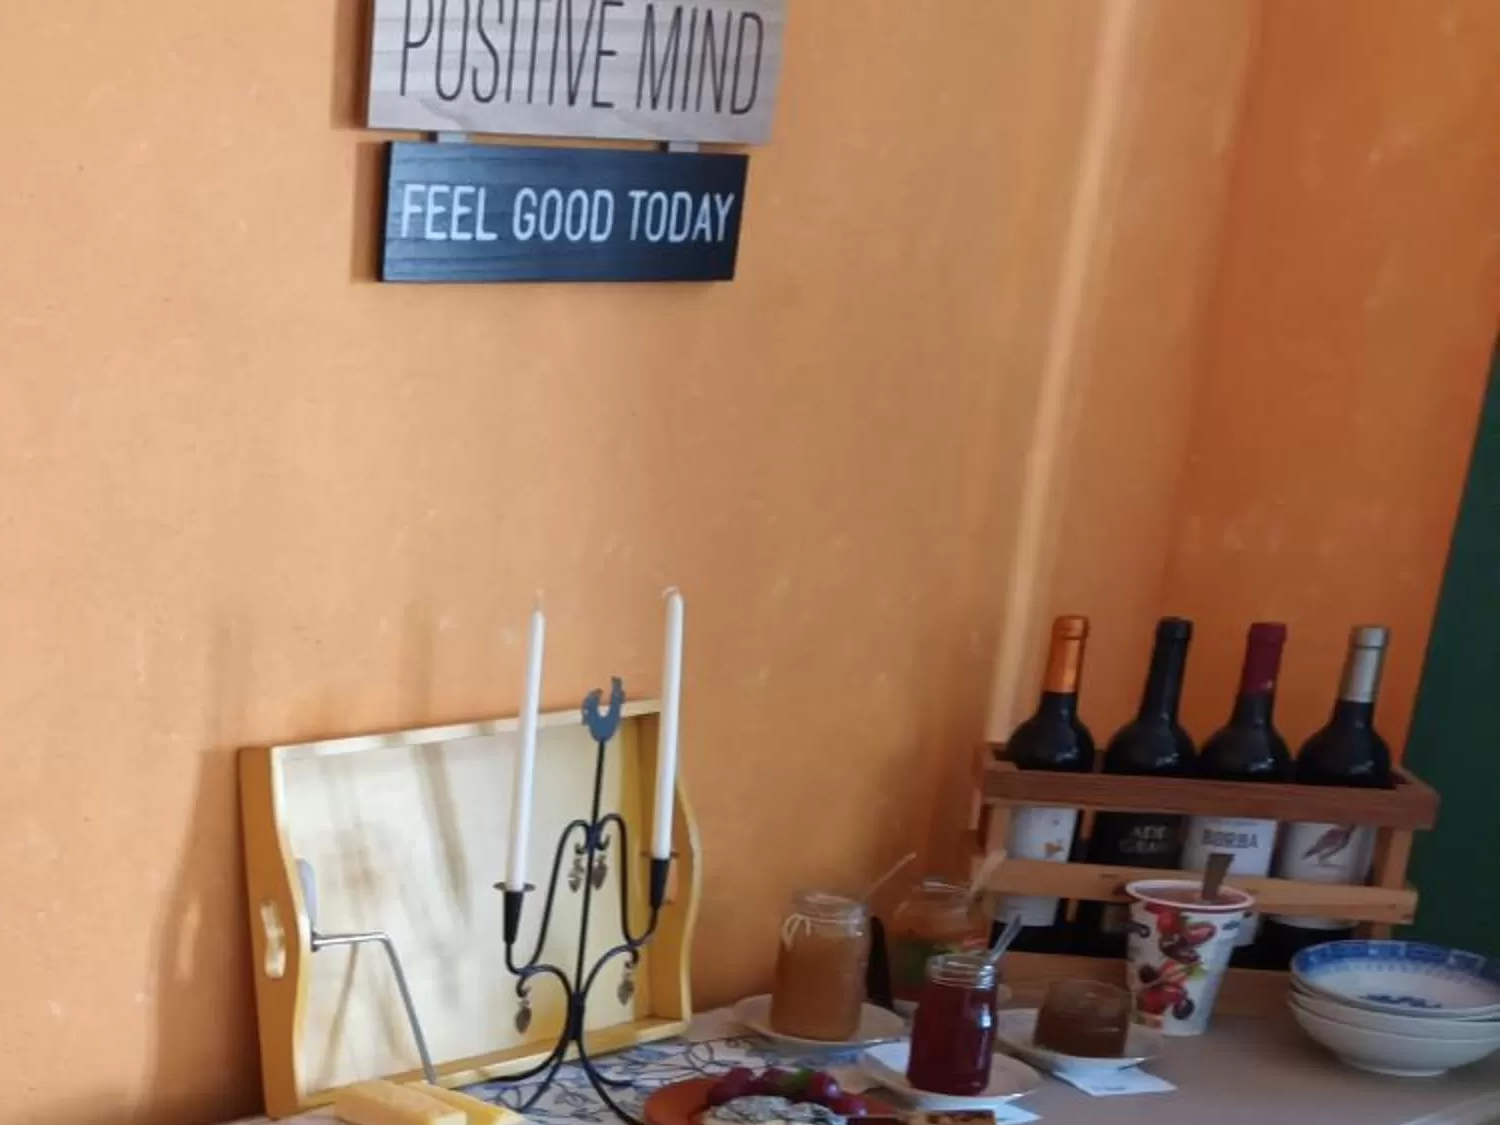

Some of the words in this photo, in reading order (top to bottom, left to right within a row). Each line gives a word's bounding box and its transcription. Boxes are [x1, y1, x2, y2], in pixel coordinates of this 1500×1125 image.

[399, 0, 624, 108] POSITIVE
[635, 3, 765, 114] MIND
[401, 183, 498, 241] FEEL
[512, 187, 614, 242] GOOD
[627, 189, 735, 243] TODAY
